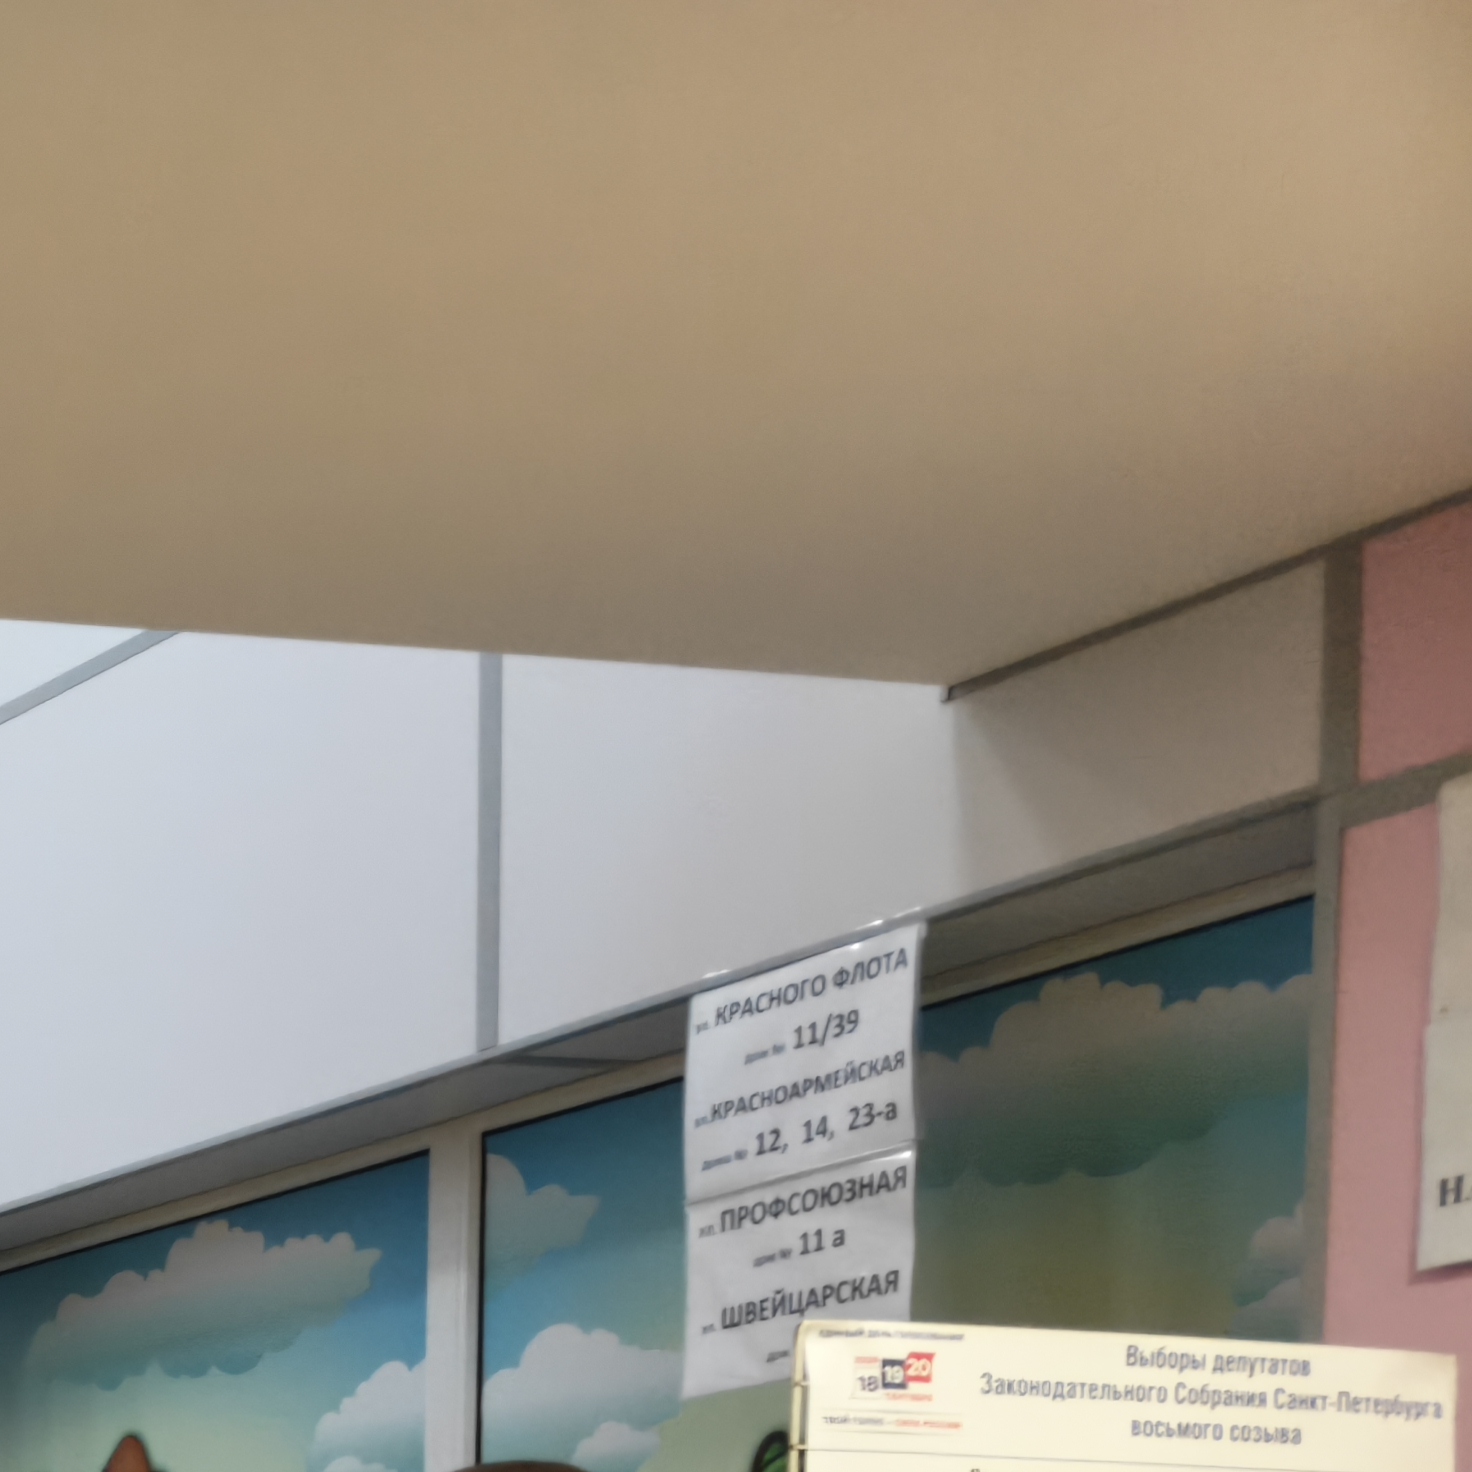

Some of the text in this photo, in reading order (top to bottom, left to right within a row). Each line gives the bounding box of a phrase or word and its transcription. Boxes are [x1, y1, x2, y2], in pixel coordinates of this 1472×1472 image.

[714, 947, 908, 1027] КРАСНОГО ФЛОТА
[792, 1008, 859, 1050] 11/39
[710, 1050, 905, 1120] КРАСНОАРМЕЙСКАЯ
[754, 1127, 789, 1156] 12,
[801, 1115, 835, 1143] 14,
[719, 1165, 907, 1233] ПРОФСОЮЗНАЯ
[798, 1228, 824, 1256] 11
[720, 1269, 900, 1330] ШВЕЙЦАРСКАЯ
[906, 1357, 932, 1377] 20
[1125, 1344, 1312, 1379] Выборы депутатов
[979, 1371, 1444, 1422] Законодательного Собрания Санкт-Петербурга
[1130, 1418, 1302, 1445] восьмого созыва
